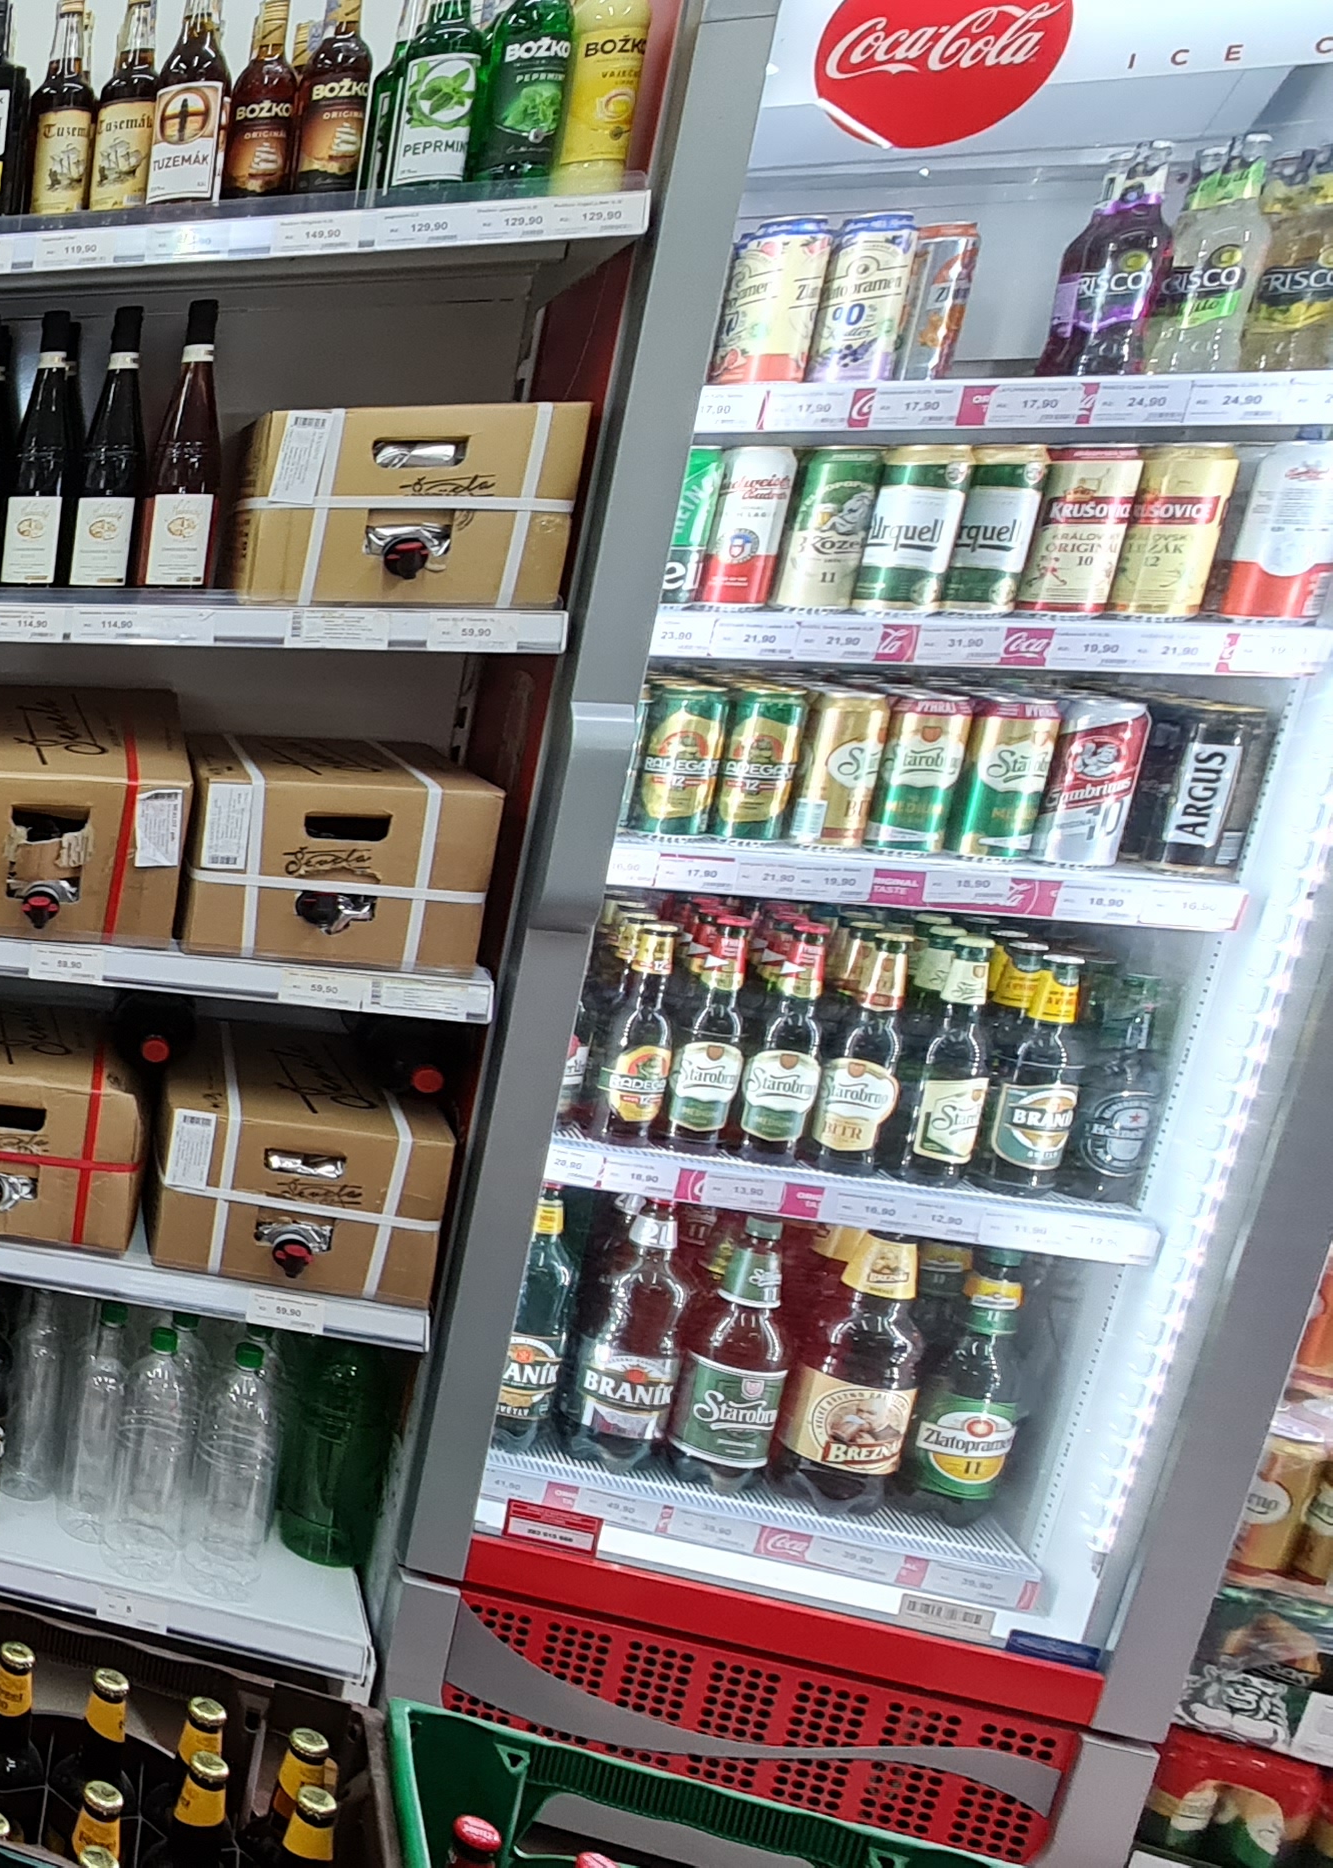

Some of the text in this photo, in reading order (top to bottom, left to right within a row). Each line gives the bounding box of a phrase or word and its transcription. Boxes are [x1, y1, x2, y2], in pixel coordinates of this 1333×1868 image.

[824, 0, 1066, 81] Coca-Cola
[505, 36, 571, 62] BOŽKO
[1127, 44, 1244, 70] ICE
[312, 81, 369, 101] BOŽKO
[235, 100, 291, 121] BOŽKO
[42, 121, 91, 138] Tuzem
[153, 153, 209, 172] TUZEMÁK
[504, 215, 543, 226] 129,90
[582, 210, 622, 221] 129,90
[410, 222, 448, 232] 129,90
[305, 229, 341, 239] 149,90
[64, 244, 97, 255] 119,90
[1022, 399, 1059, 409] 17,90
[1127, 396, 1167, 407] 24,90
[1222, 395, 1262, 405] 24,90
[798, 404, 832, 414] 17,90
[904, 401, 940, 411] 17,90
[1077, 555, 1094, 567] 10
[820, 572, 836, 583] 11
[17, 618, 48, 629] 114,90
[101, 619, 133, 630] 114,90
[461, 627, 492, 638] 59,90
[743, 634, 776, 644] 21,90
[947, 638, 983, 648] 31,90
[1083, 644, 1119, 654] 19,90
[1175, 750, 1227, 839] ARGUS
[686, 869, 717, 878] 17,90
[823, 877, 857, 887] 19,90
[956, 879, 990, 889] 18,90
[1089, 897, 1124, 907] 18,90
[310, 983, 338, 994] 59,90
[734, 1185, 764, 1196] 13,90
[642, 1224, 673, 1246] 2L
[275, 1306, 302, 1318] 59,90
[503, 1361, 558, 1386] ANÍK
[584, 1369, 672, 1406] BRANÍK
[923, 1426, 1014, 1453] Zlatoprame
[963, 1459, 981, 1475] 11
